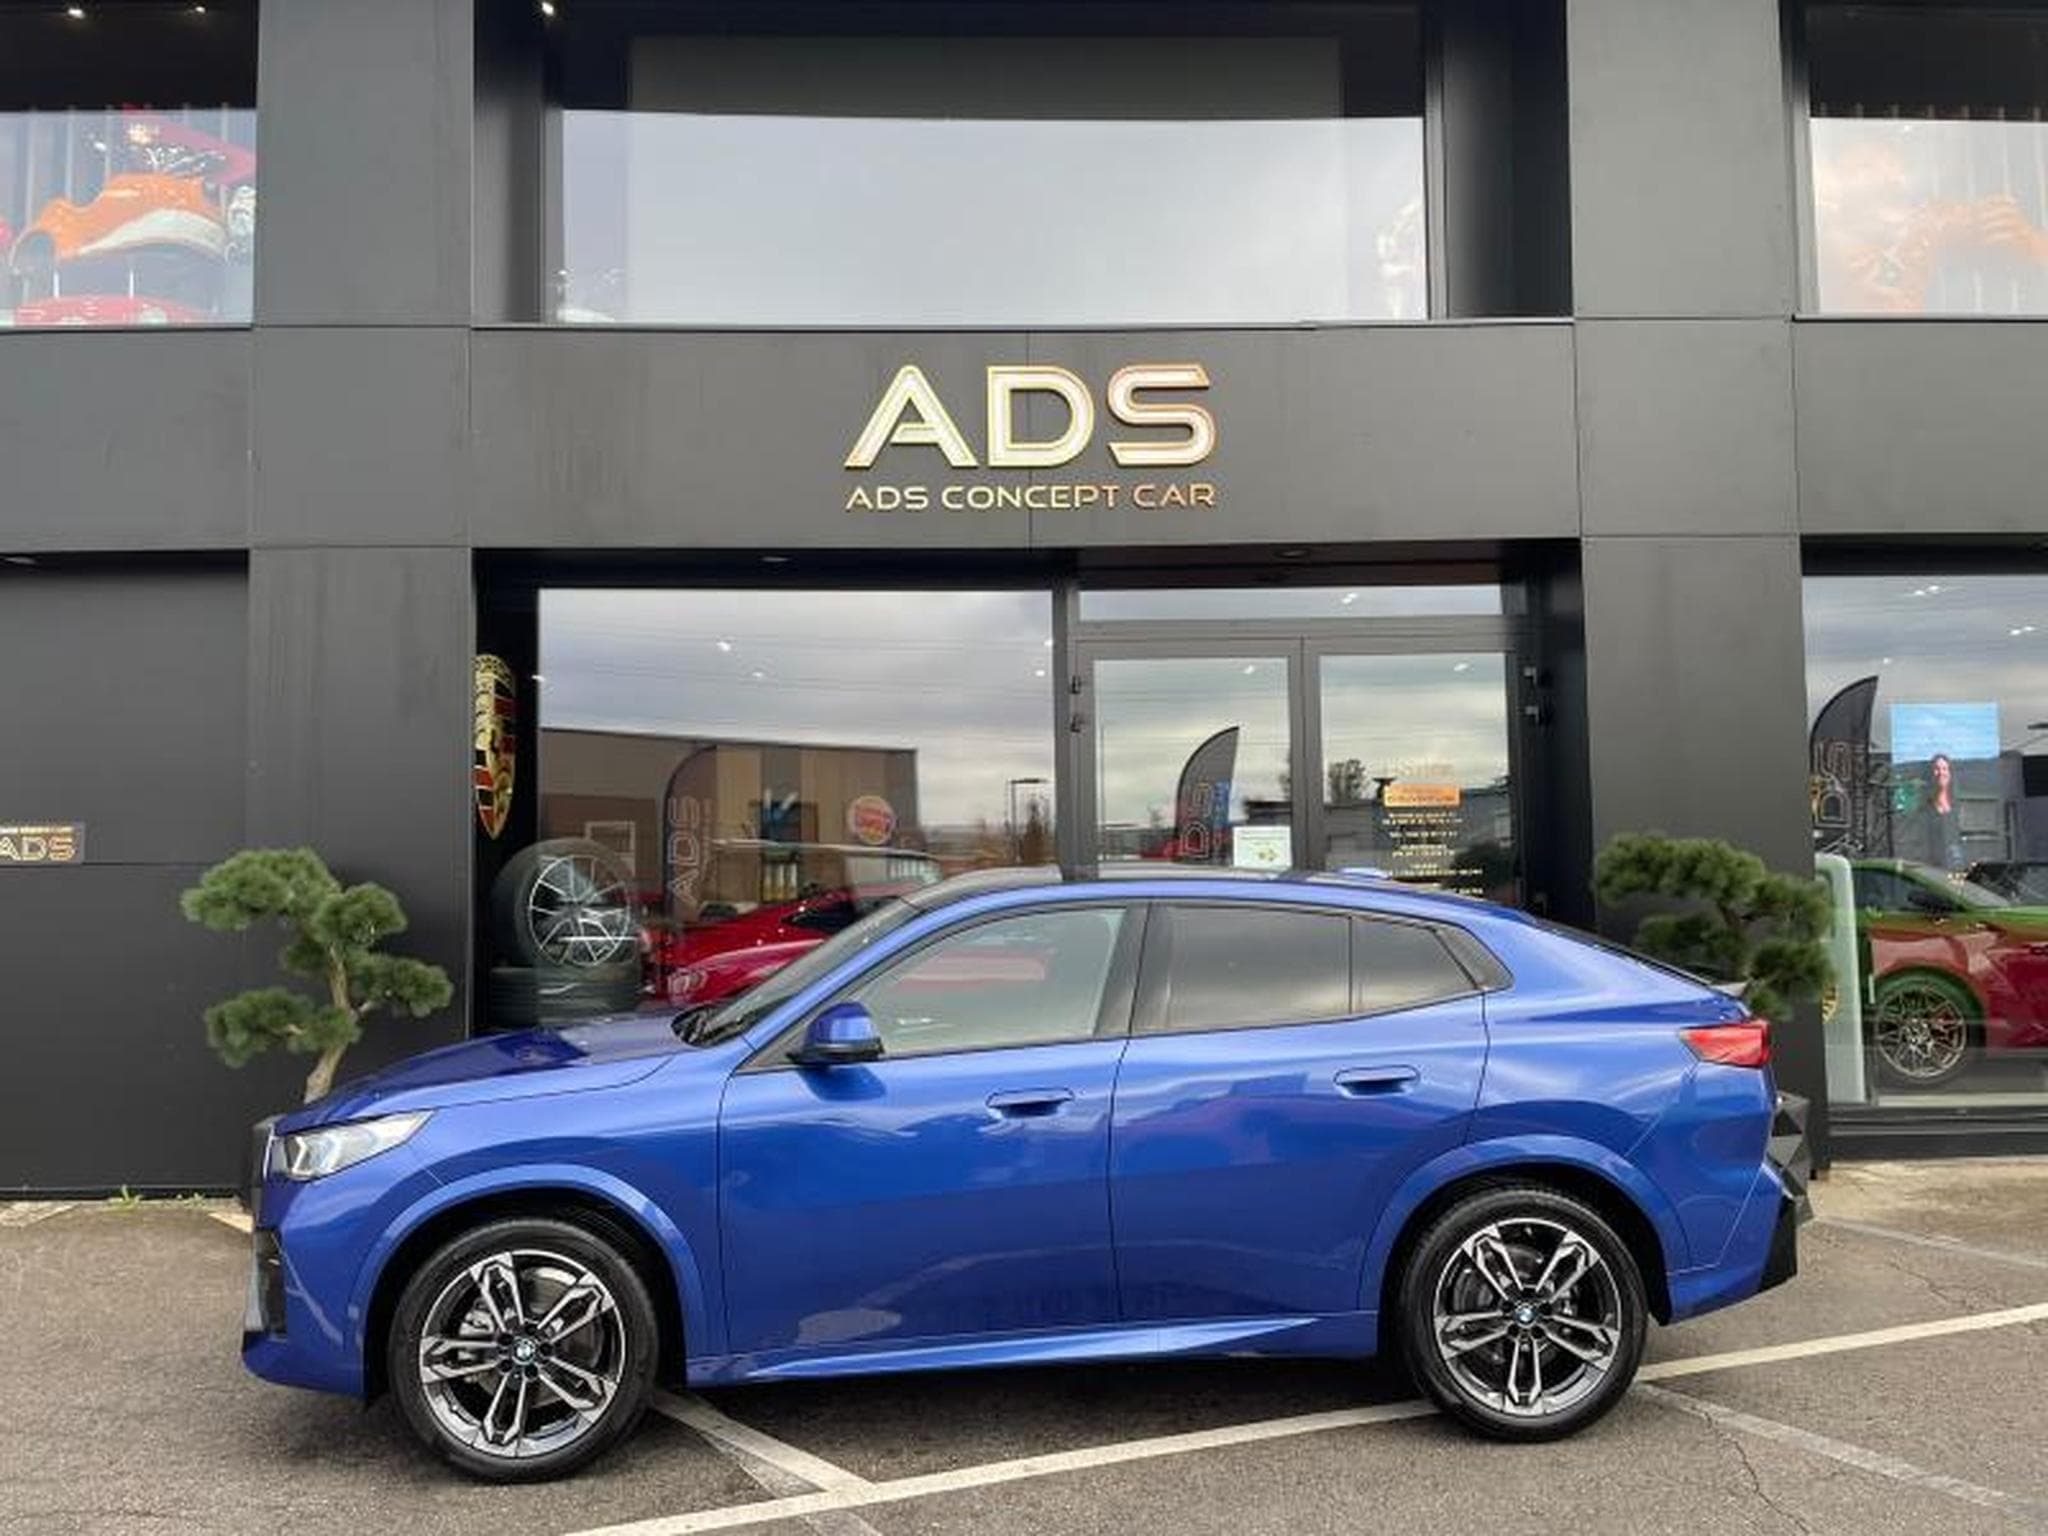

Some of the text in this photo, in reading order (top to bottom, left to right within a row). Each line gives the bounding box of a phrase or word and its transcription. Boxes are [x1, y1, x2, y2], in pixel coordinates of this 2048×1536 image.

[844, 364, 1216, 468] ADS
[845, 483, 1216, 510] ADS CONCEPT CAR
[0, 836, 76, 861] ADS
